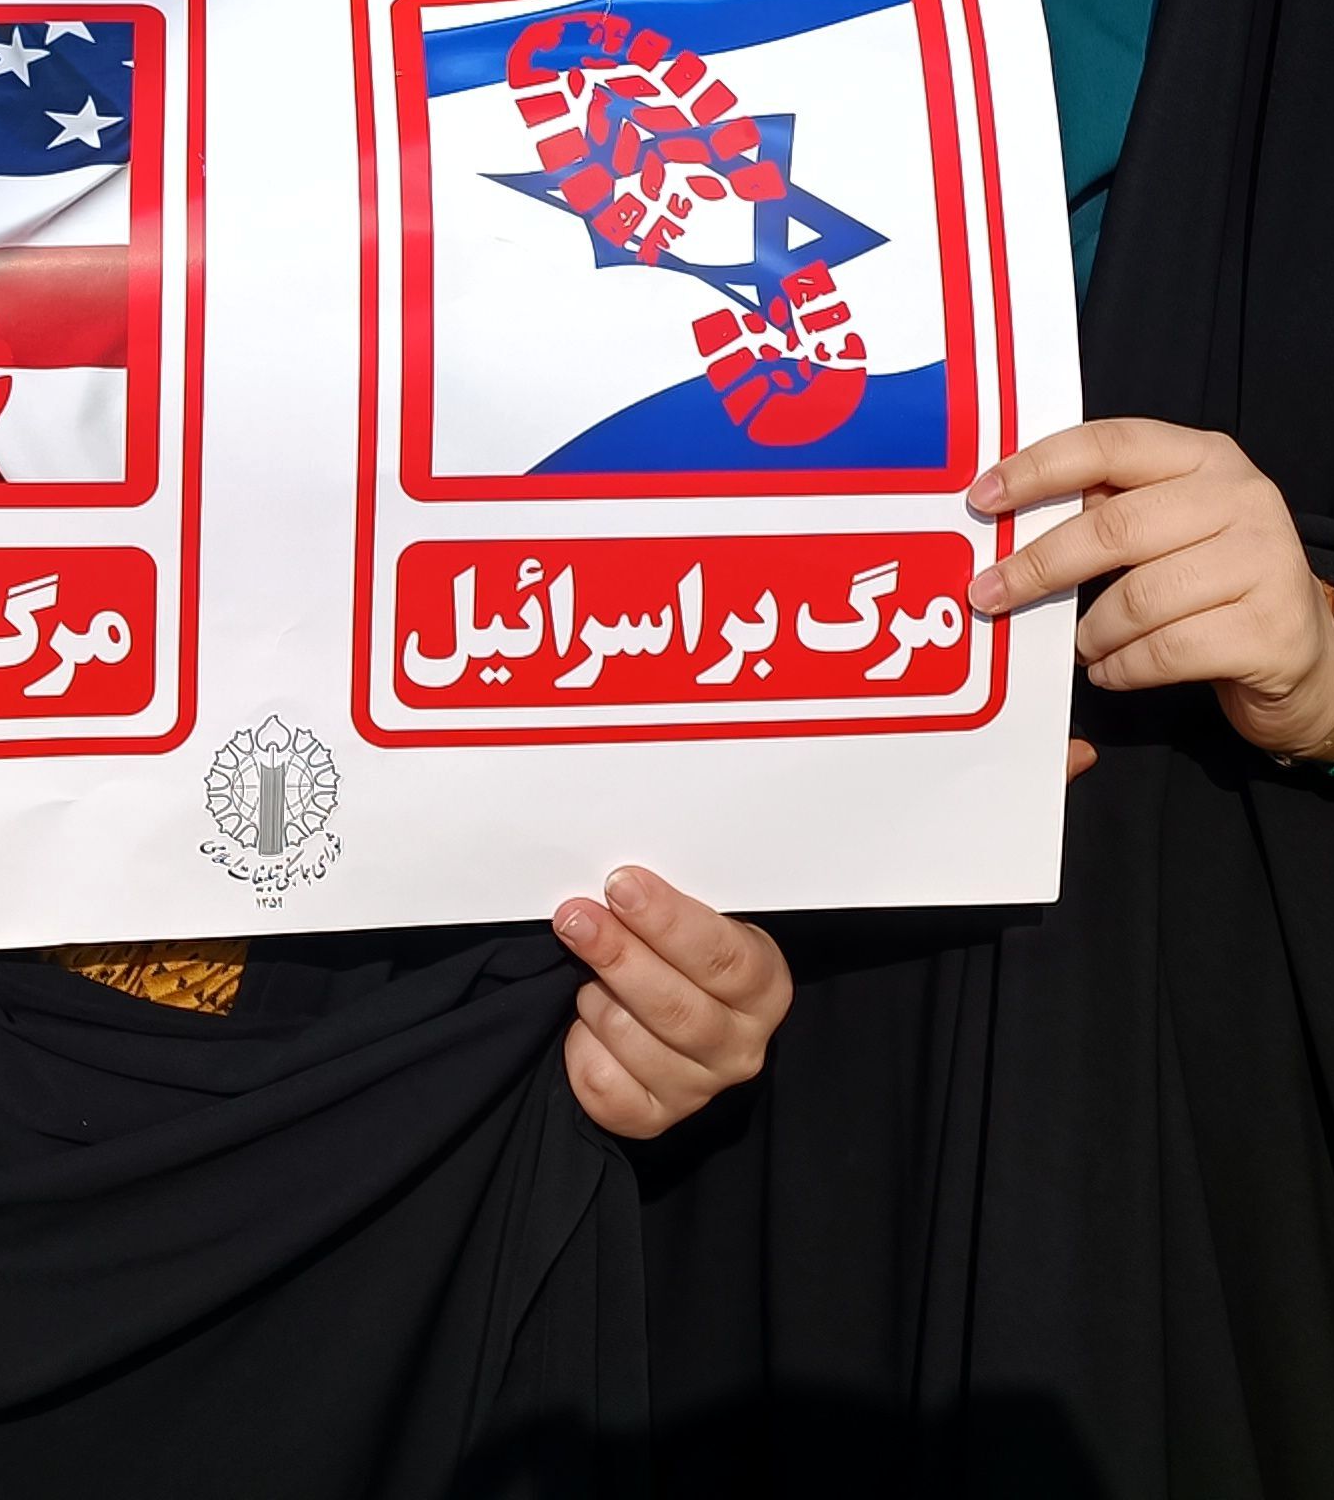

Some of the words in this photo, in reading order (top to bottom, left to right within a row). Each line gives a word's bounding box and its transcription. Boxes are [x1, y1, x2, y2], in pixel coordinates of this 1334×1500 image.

[402, 557, 704, 689] اسرائیل
[694, 588, 780, 686] بر
[795, 559, 965, 683] مرگ
